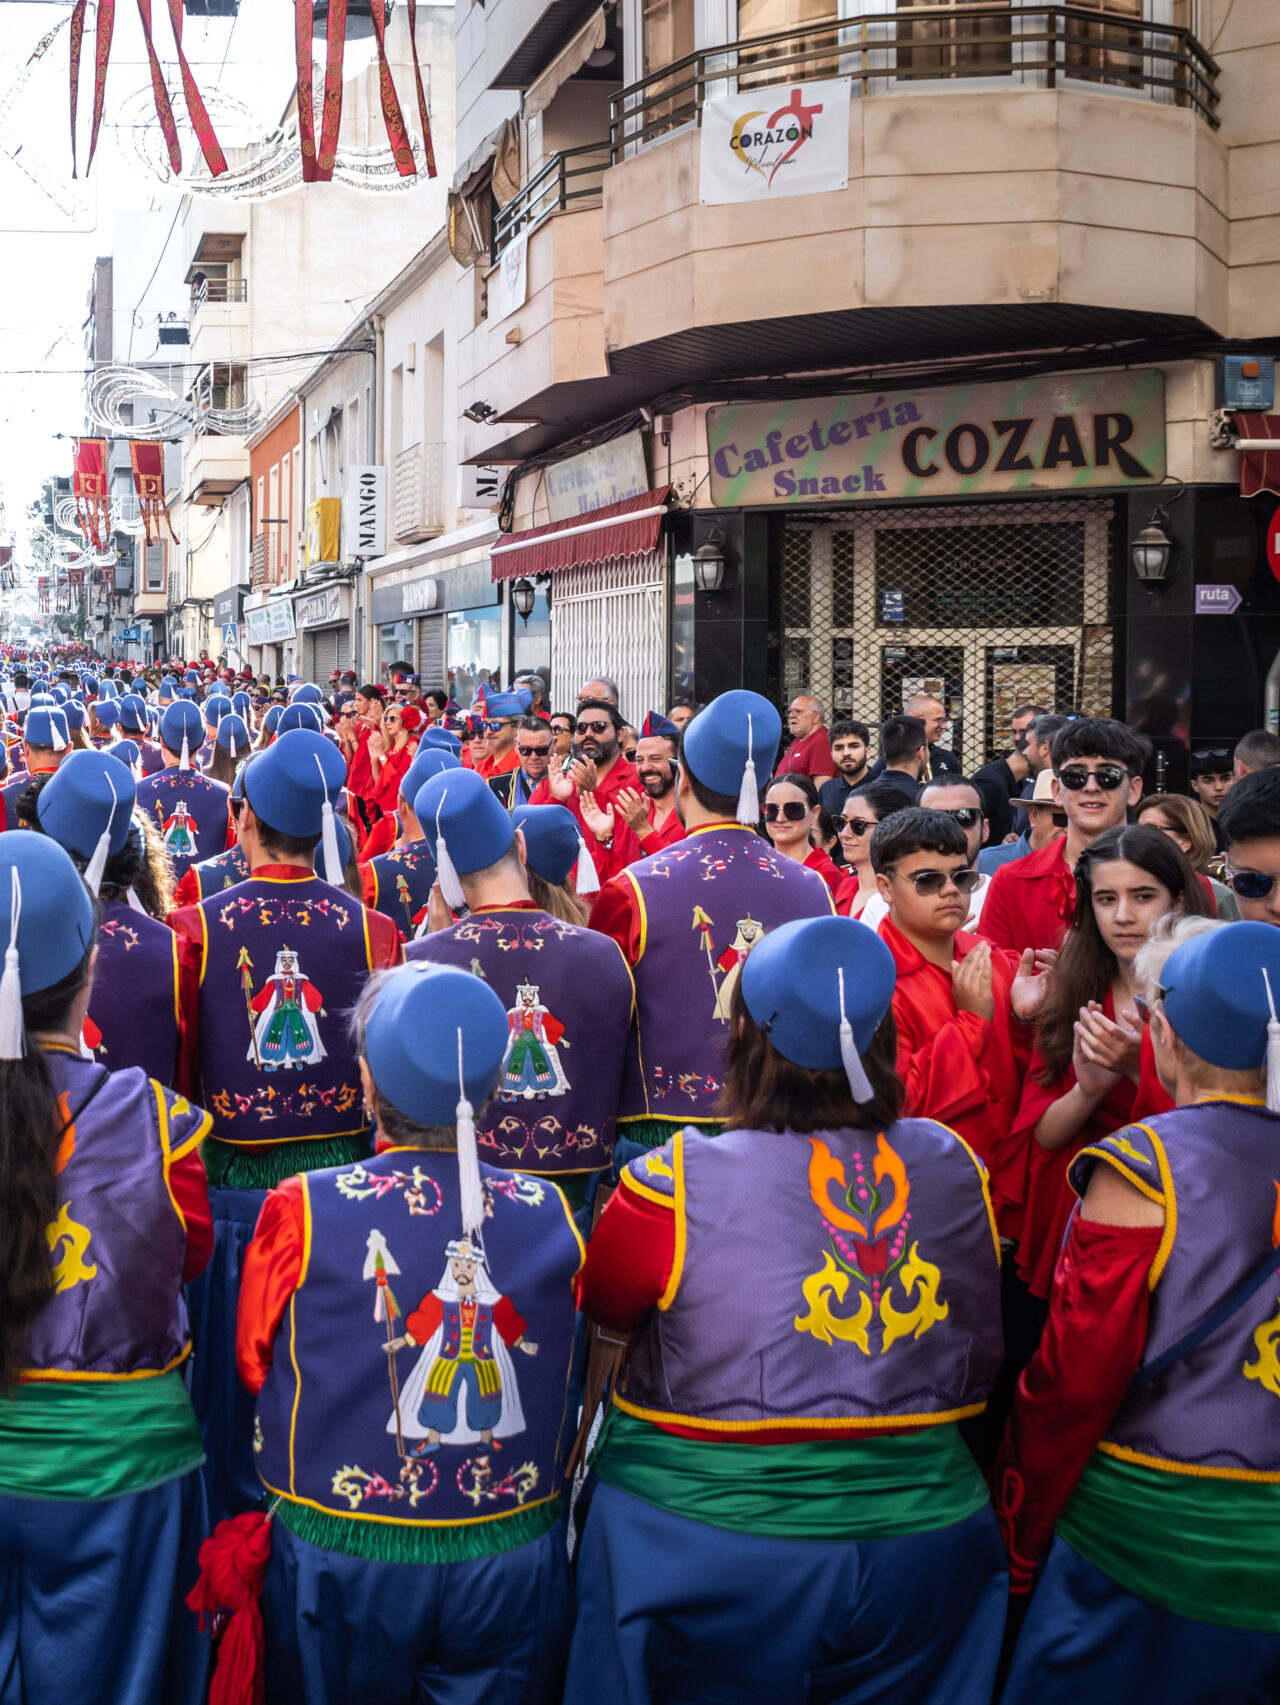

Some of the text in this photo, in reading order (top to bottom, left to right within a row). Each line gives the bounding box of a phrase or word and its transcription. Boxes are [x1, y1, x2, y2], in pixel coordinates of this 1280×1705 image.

[730, 123, 813, 150] CORAZÓN
[713, 396, 1156, 480] Cafetería COZAR
[773, 465, 887, 498] Snack
[359, 472, 377, 548] MANGO
[1200, 588, 1229, 600] ruta
